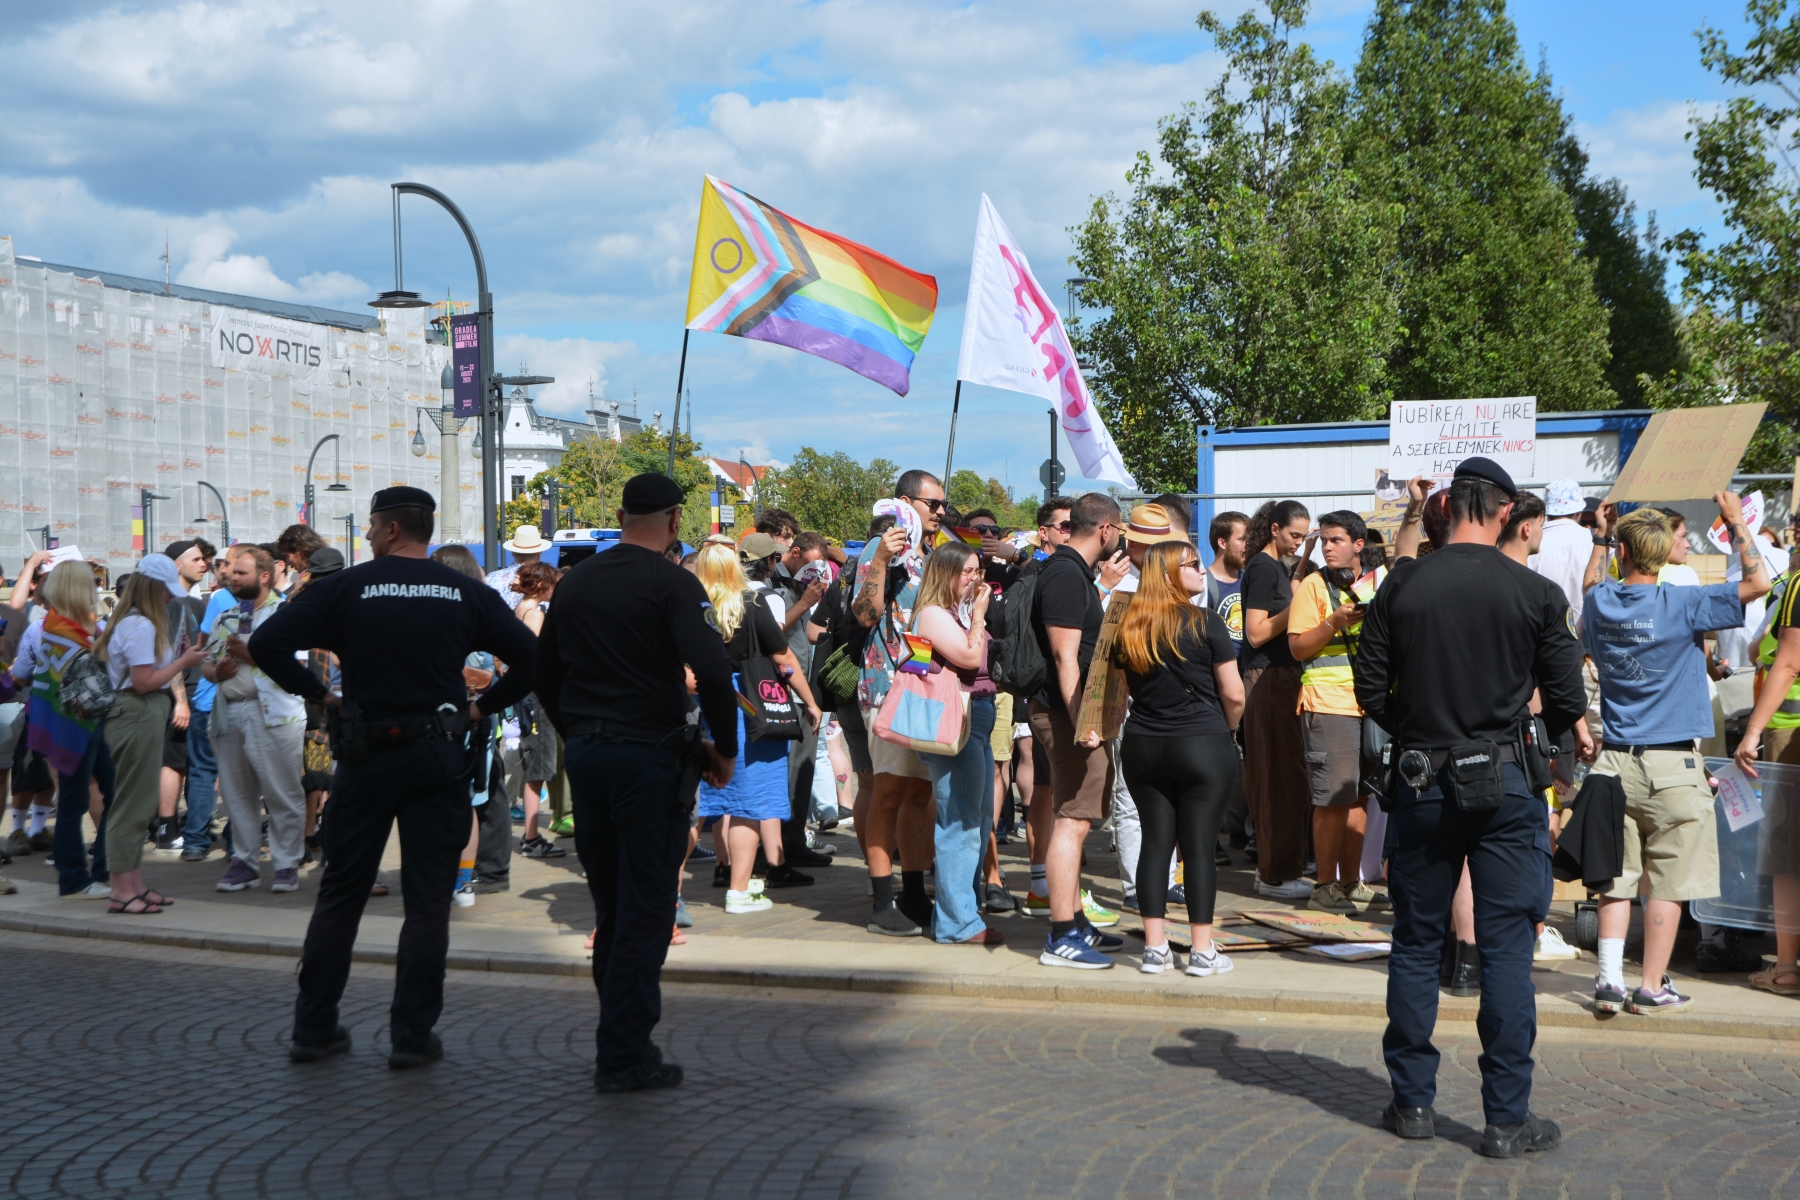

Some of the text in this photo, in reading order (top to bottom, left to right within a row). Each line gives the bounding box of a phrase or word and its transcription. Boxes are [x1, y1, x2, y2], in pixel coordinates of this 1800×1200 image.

[454, 325, 477, 335] ORADEA
[454, 333, 478, 342] SUMMER
[220, 328, 321, 367] NOVARTIS
[464, 340, 478, 348] FILM
[1475, 404, 1497, 420] NU
[1502, 402, 1533, 420] ARE
[1723, 409, 1743, 429] E
[1392, 438, 1534, 457] A SZERELEMNEK NINCS
[360, 583, 462, 602] JANDARMERIA
[1634, 618, 1654, 629] lasă
[1729, 775, 1751, 814] YOURSELF
